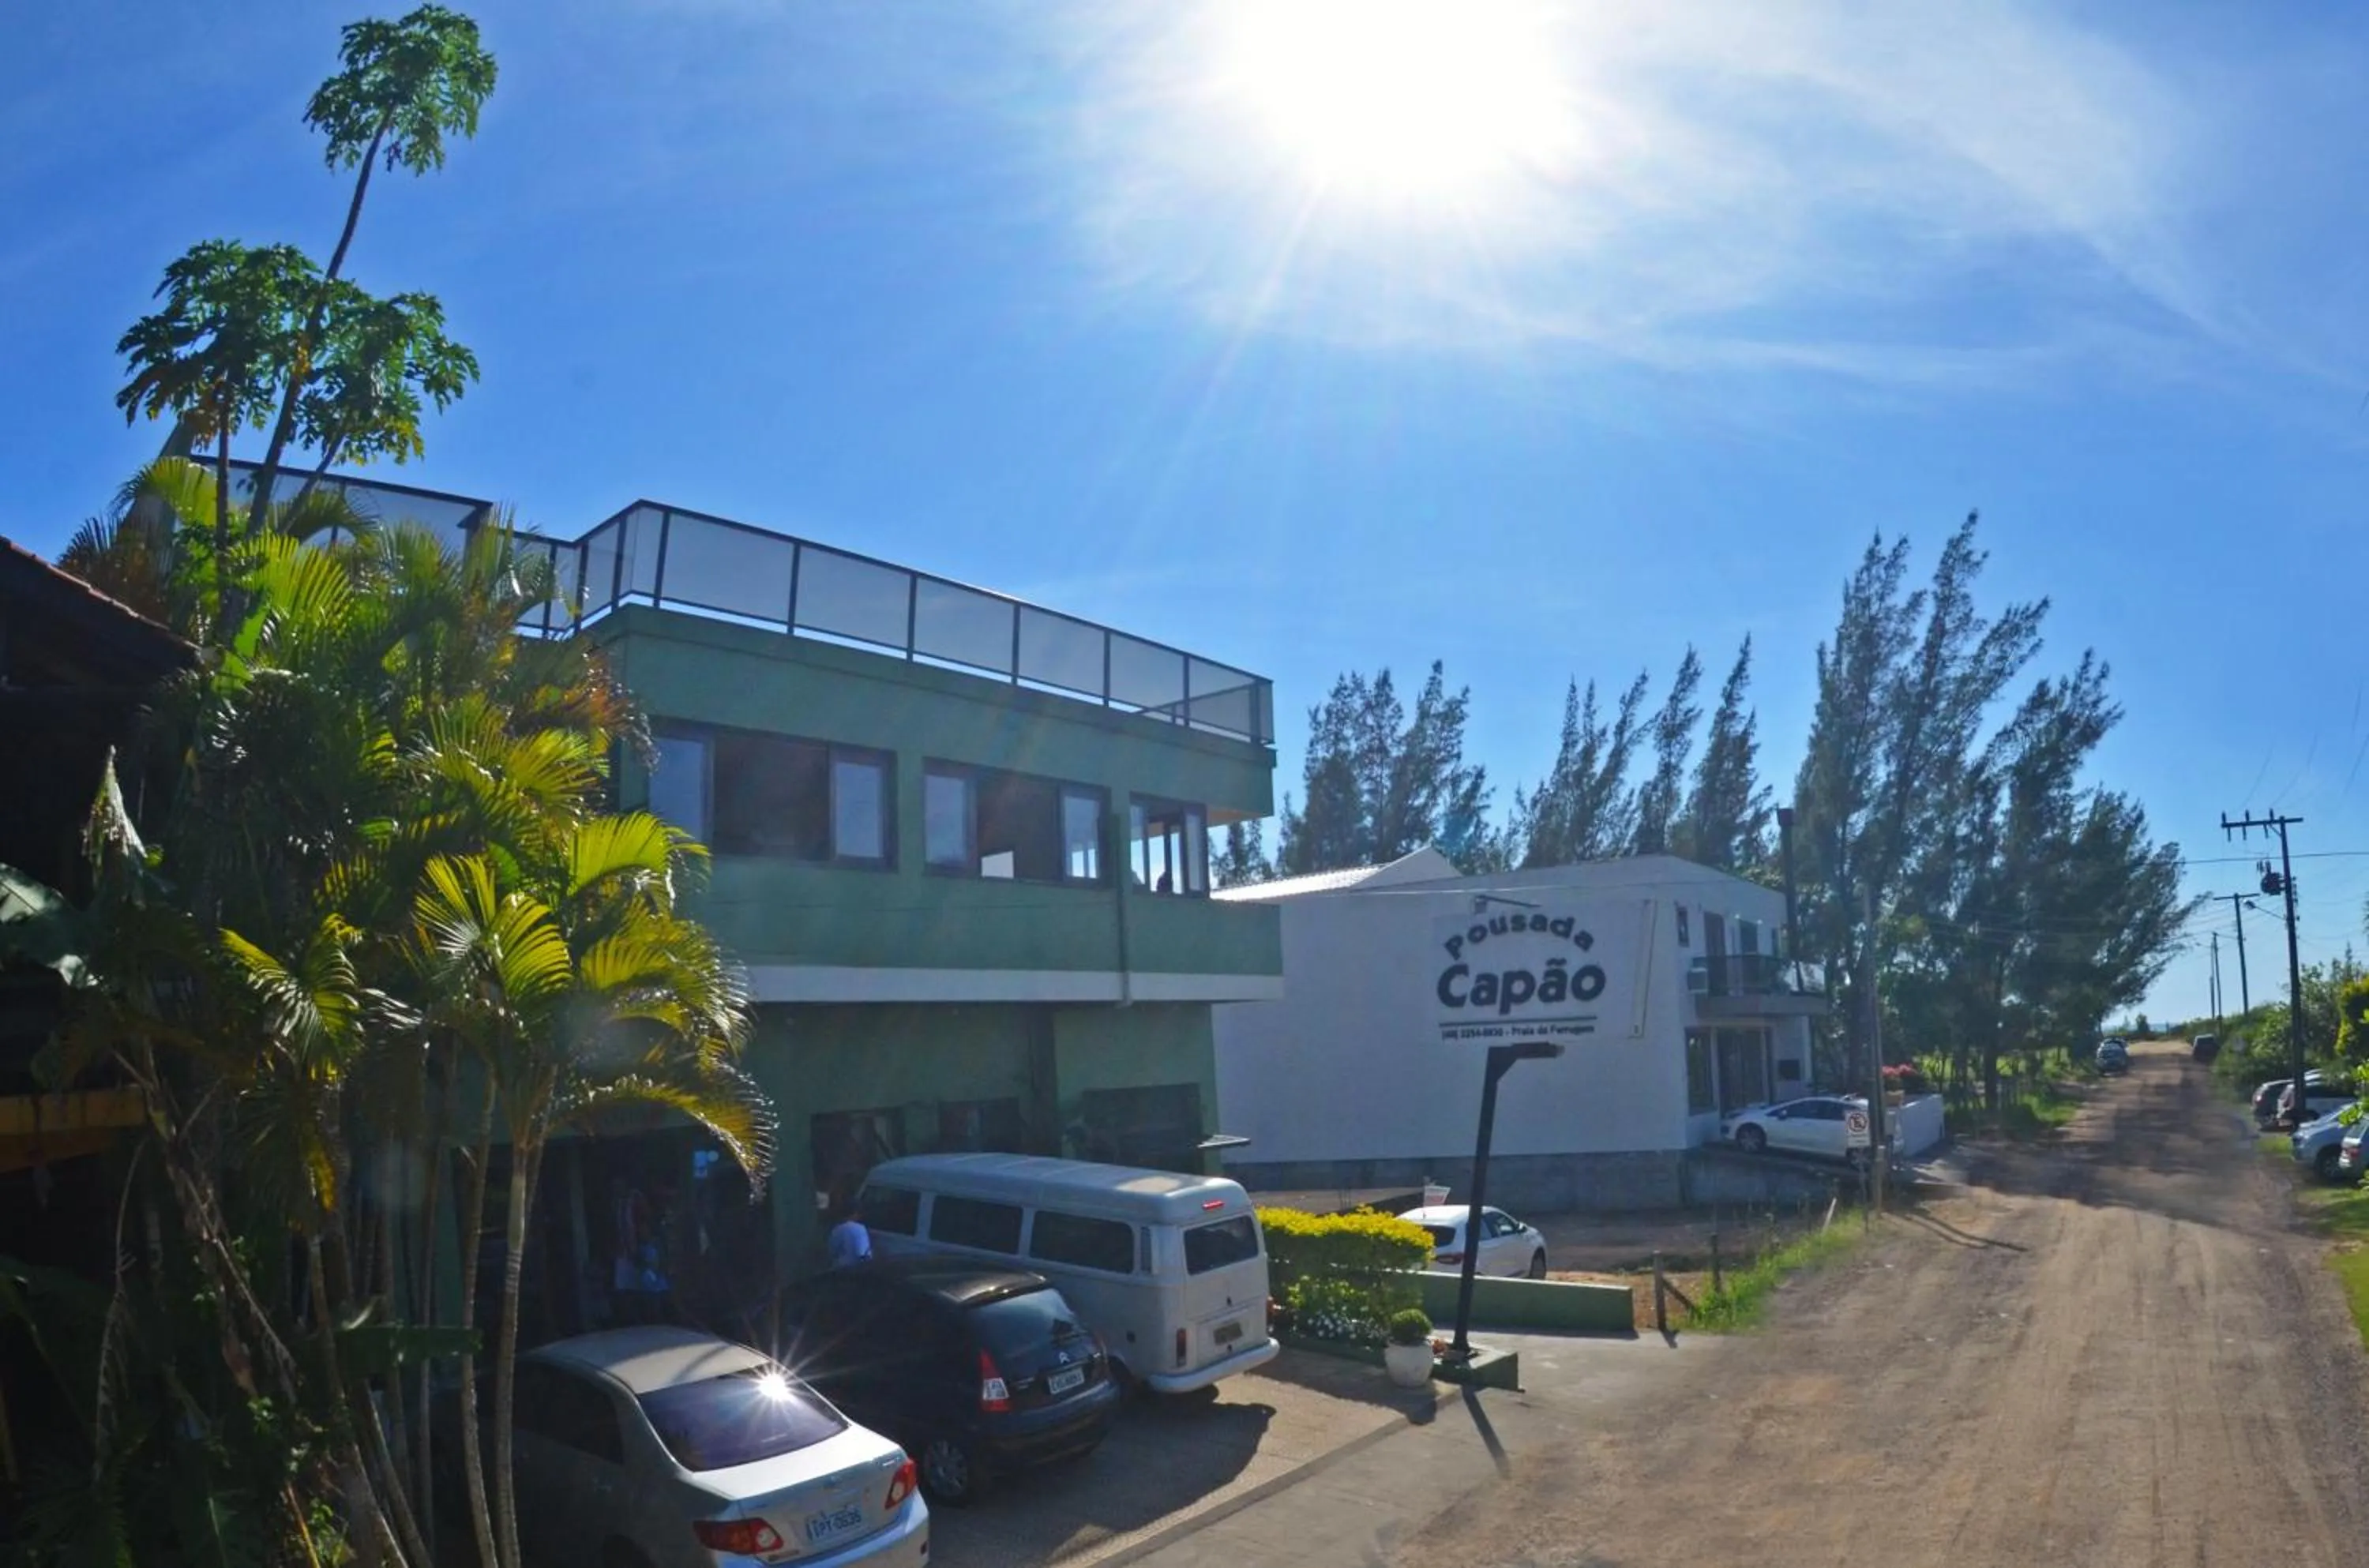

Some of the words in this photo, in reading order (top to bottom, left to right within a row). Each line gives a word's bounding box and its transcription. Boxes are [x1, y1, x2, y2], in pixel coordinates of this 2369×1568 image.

[1444, 913, 1594, 961] Pousada
[1436, 958, 1606, 1015] Capão
[1511, 1026, 1534, 1036] Praia
